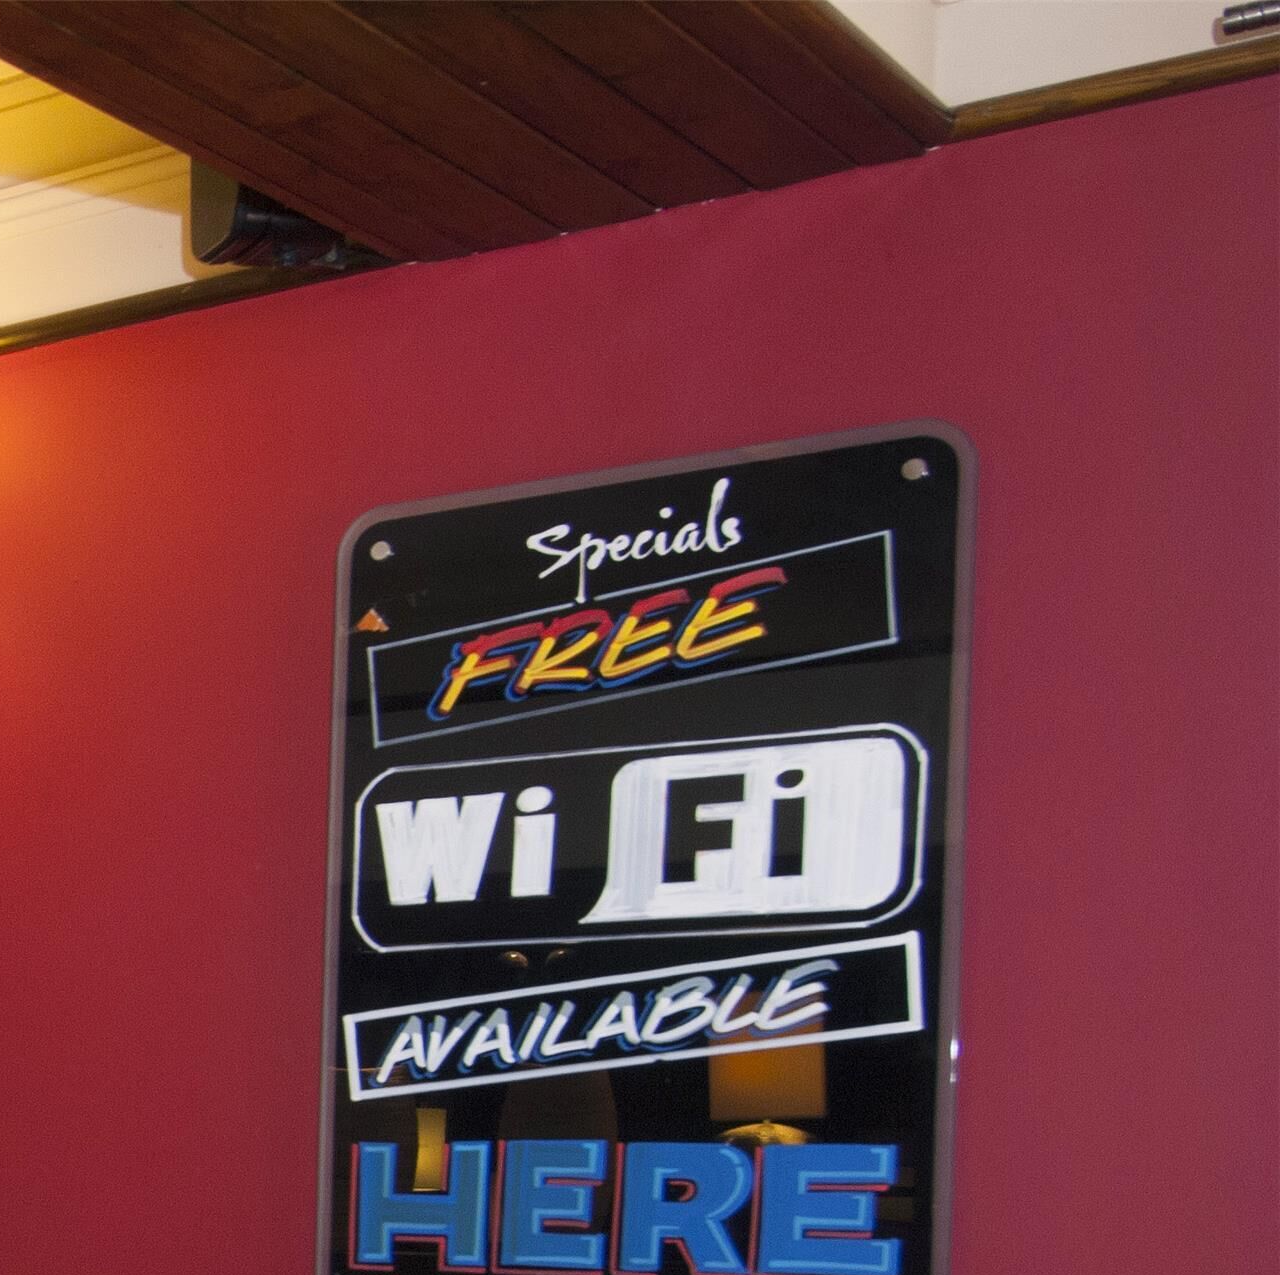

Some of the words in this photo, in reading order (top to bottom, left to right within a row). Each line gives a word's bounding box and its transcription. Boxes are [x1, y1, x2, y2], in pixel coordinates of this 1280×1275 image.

[527, 478, 741, 604] Specials
[427, 566, 788, 721] FREE
[375, 786, 555, 907] Wi
[662, 768, 808, 885] Fi
[369, 959, 839, 1088] AVAILABLE
